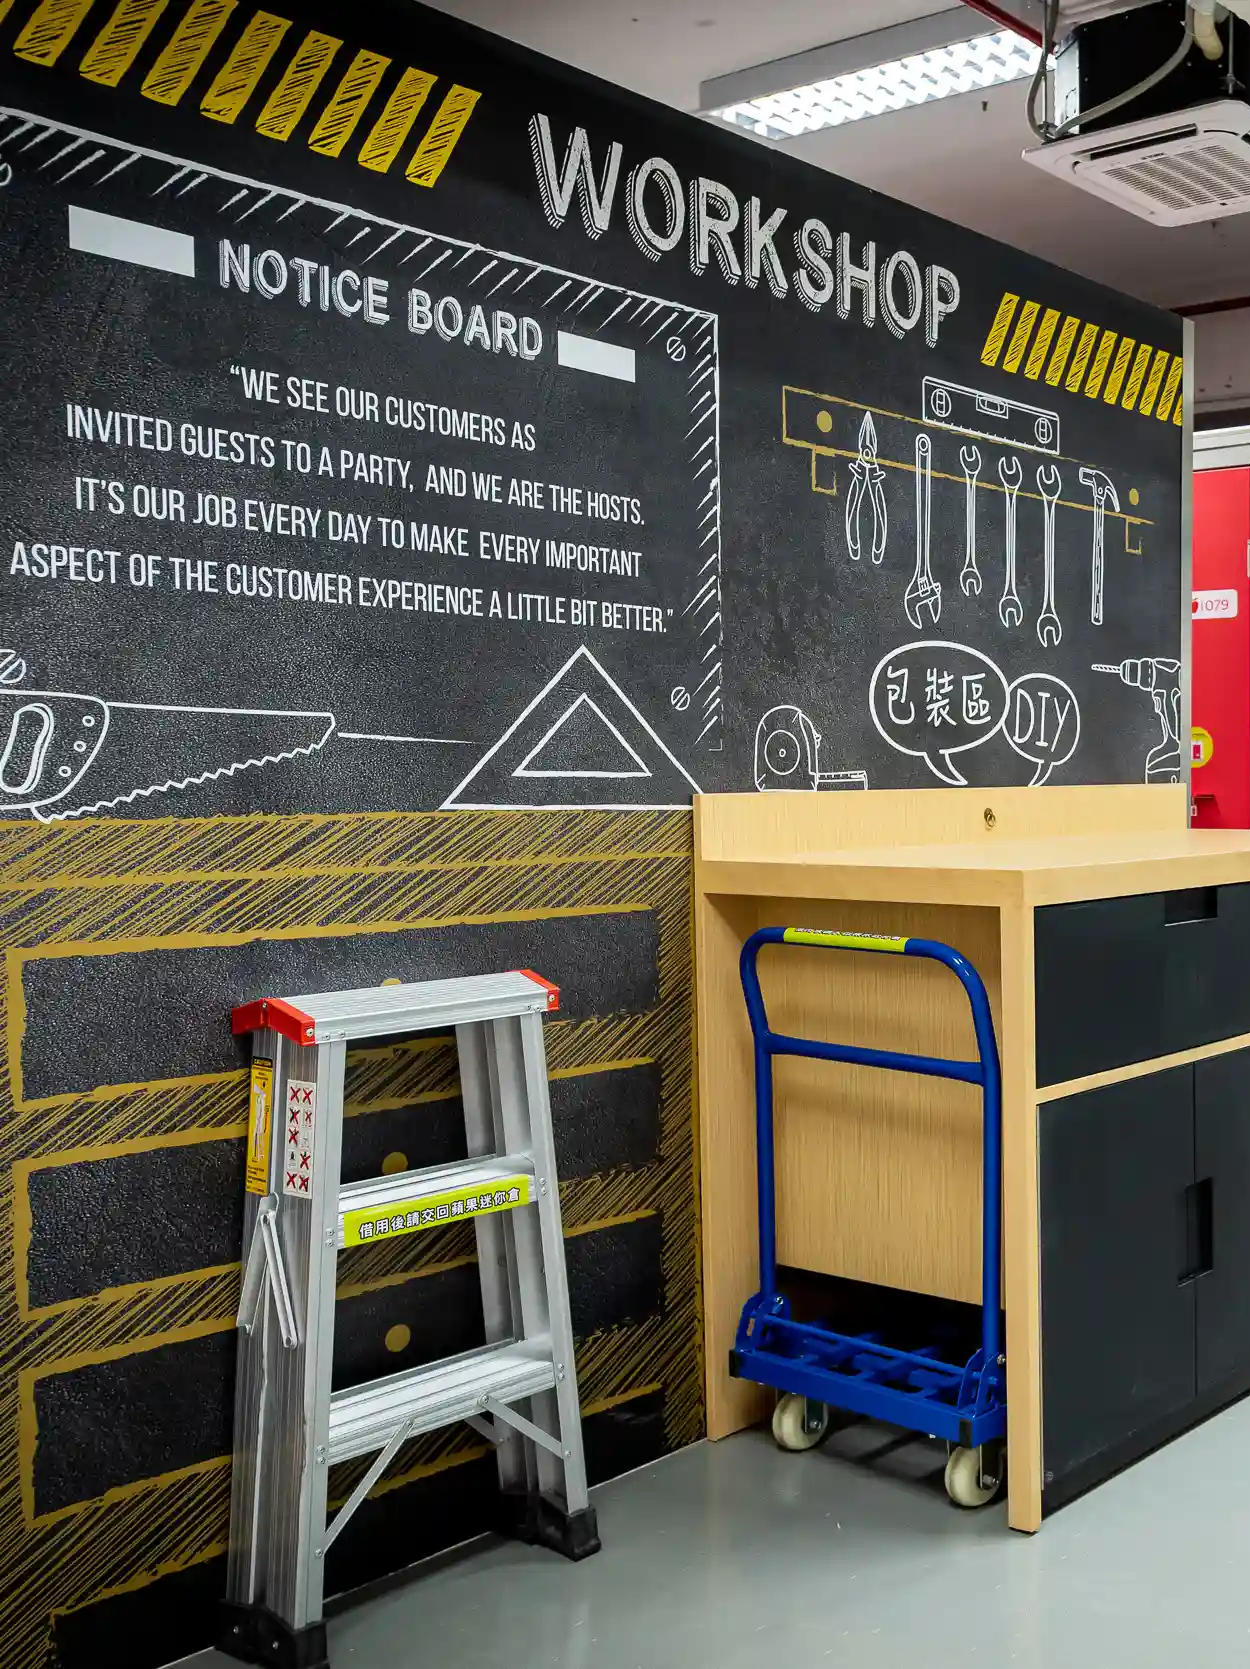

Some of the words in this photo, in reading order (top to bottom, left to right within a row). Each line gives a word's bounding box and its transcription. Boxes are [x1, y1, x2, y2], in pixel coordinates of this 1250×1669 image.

[528, 113, 960, 348] WORKSHOP
[218, 238, 390, 325] NOTICE
[407, 288, 543, 360] BOARD
[286, 376, 330, 414] SEE
[335, 386, 380, 423] OUR
[385, 396, 506, 446] CUSTOMERS
[510, 421, 536, 452] AS
[66, 403, 173, 452] INVITED
[180, 423, 275, 468] GUESTS
[280, 439, 312, 474] TO
[318, 446, 334, 478] A
[340, 449, 415, 492] PARTY,
[425, 464, 467, 497] AND
[471, 471, 503, 504] WE
[507, 478, 545, 510] ARE
[548, 484, 583, 516] THE
[587, 490, 645, 526] HOSTS.
[132, 484, 186, 523] OUR
[192, 492, 237, 528] JOB
[244, 499, 322, 539] EVERY
[328, 510, 372, 545] DAY
[377, 517, 405, 549] TO
[410, 521, 470, 557] MAKE
[479, 531, 541, 565] EVERY
[545, 539, 643, 578] IMPORTANT
[9, 541, 122, 584] ASPECT
[128, 553, 162, 588] OF
[168, 556, 219, 594] THE
[225, 563, 353, 605] CUSTOMER
[358, 576, 484, 617] EXPERIENCE
[488, 590, 503, 619] A
[507, 591, 567, 624] LITTLE
[570, 598, 598, 627] BIT
[886, 665, 991, 727] 包裝區
[1012, 688, 1071, 753] DIY
[359, 1187, 521, 1239] 借用後請交回蘋果迷你倉
